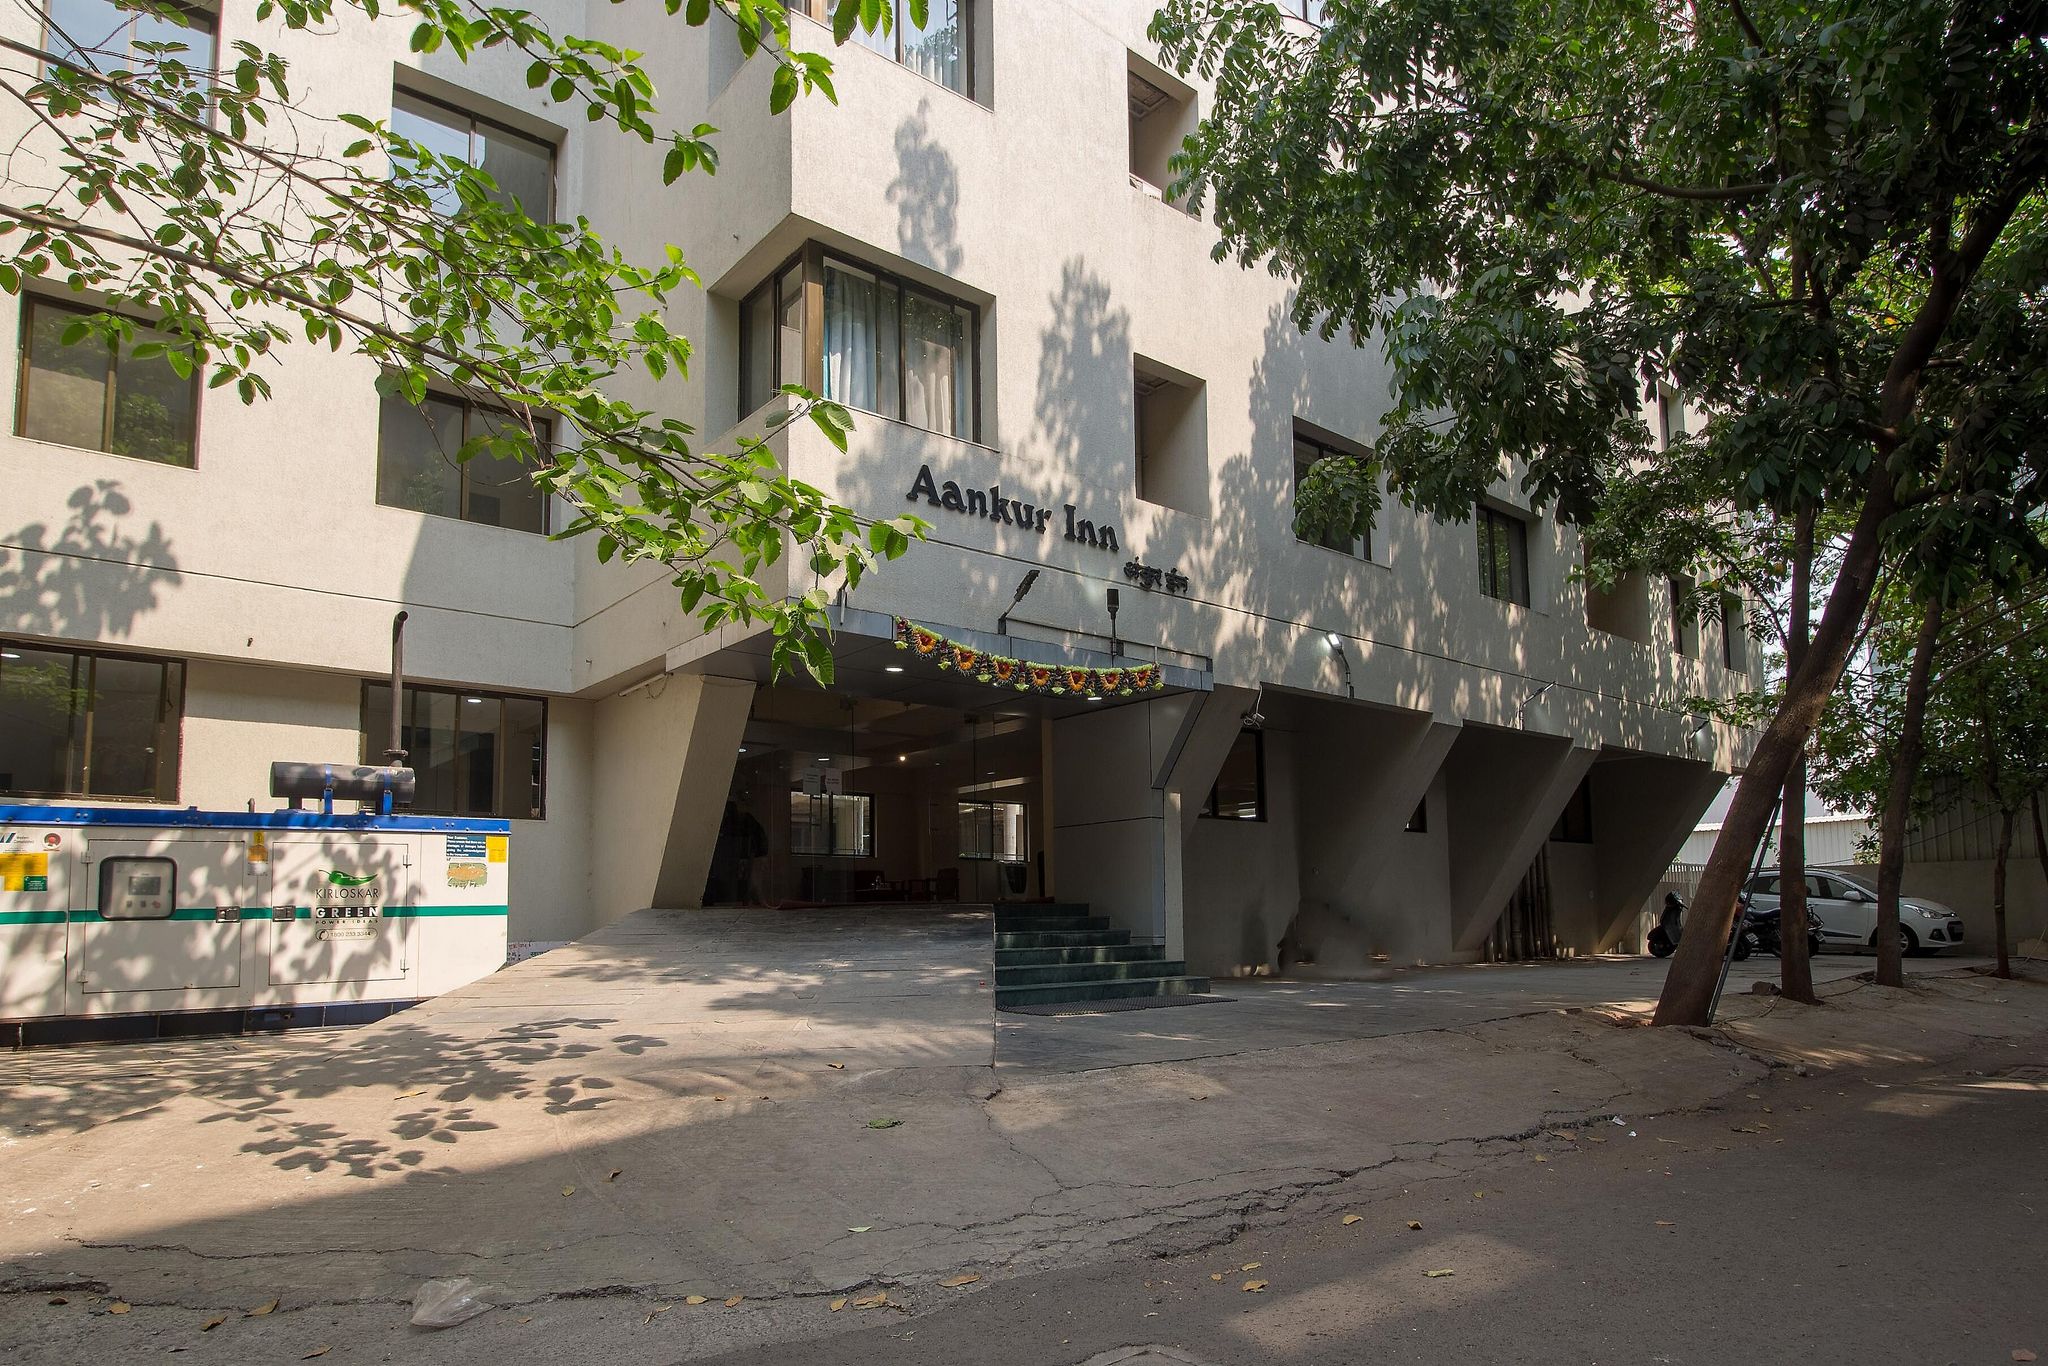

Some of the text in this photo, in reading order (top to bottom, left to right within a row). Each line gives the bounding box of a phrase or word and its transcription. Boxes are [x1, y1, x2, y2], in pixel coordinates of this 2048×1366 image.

[906, 464, 1119, 551] Aankur Inn
[315, 888, 379, 899] KIRLOSKAR
[316, 907, 378, 918] GREEN
